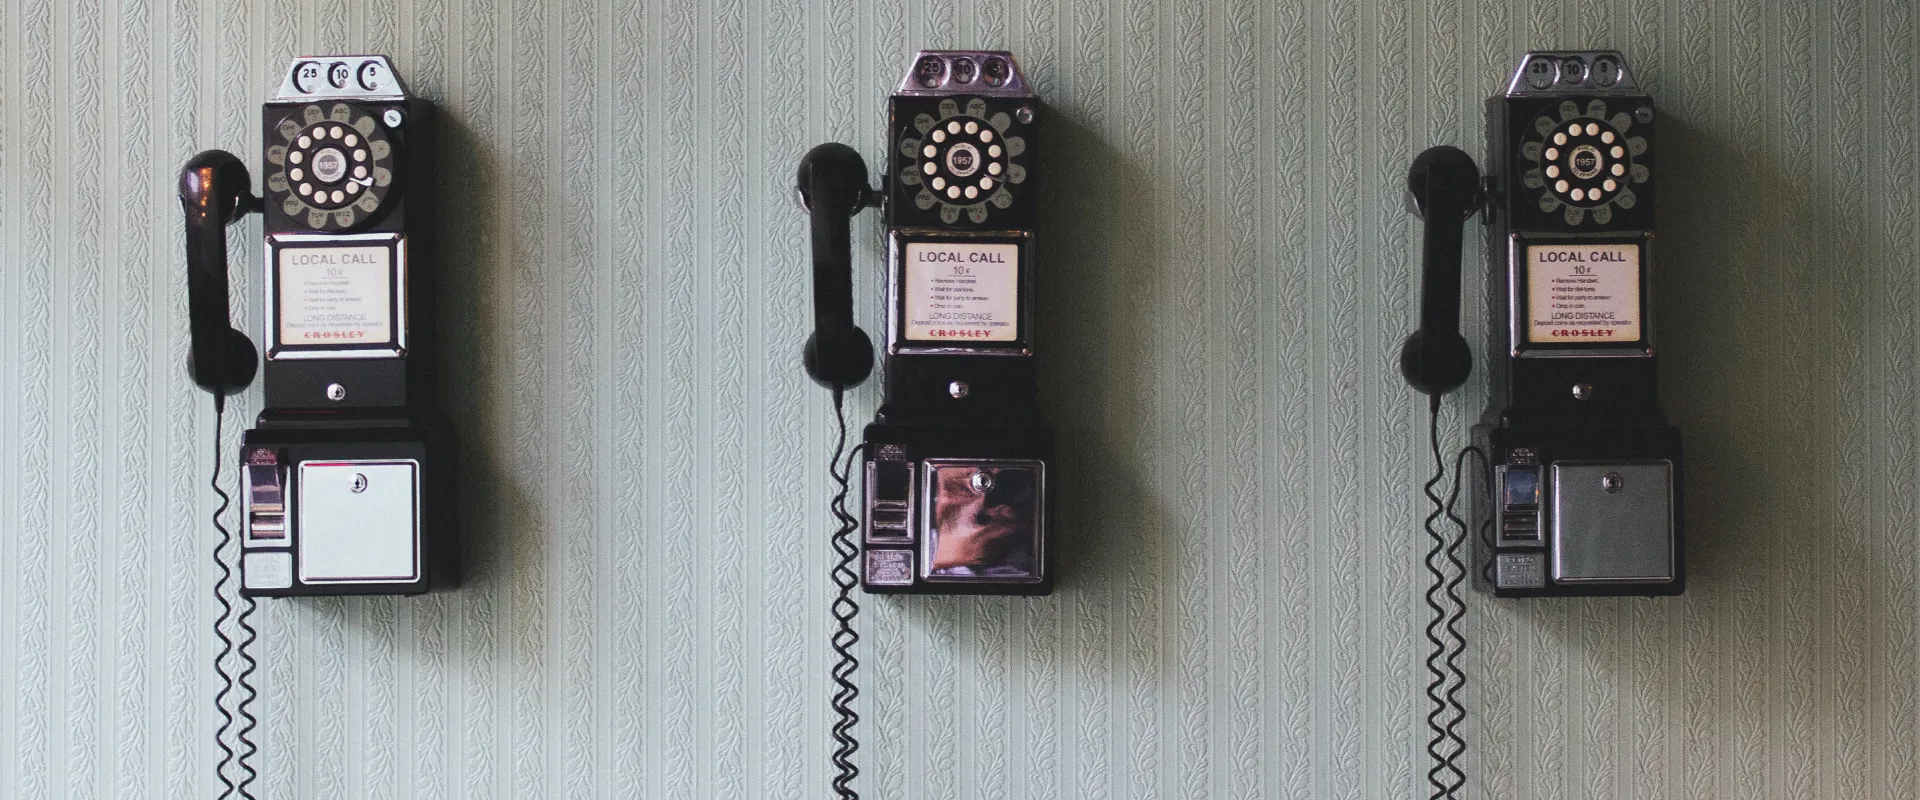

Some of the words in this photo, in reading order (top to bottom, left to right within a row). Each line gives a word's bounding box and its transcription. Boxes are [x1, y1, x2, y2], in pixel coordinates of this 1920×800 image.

[369, 67, 376, 77] 5
[1533, 62, 1548, 74] 25
[1567, 64, 1580, 75] 10
[1600, 62, 1608, 73] 5
[303, 68, 317, 78] 25
[336, 69, 349, 79] 10
[952, 156, 973, 165] 1957
[1576, 158, 1596, 166] 1957
[318, 161, 338, 170] 1957
[292, 254, 337, 265] LOCAL
[341, 254, 377, 265] CALL
[919, 252, 965, 263] LOCAL
[969, 252, 1006, 263] CALL
[1539, 252, 1586, 263] LOCAL
[1590, 251, 1627, 262] CALL
[953, 266, 964, 275] 10
[1574, 265, 1585, 274] 10
[303, 314, 325, 322] LONG
[929, 312, 951, 320] LONG
[953, 312, 993, 321] DISTANCE
[1551, 312, 1574, 320] LONG
[304, 331, 366, 339] CROSLEY
[929, 329, 991, 337] CROSLEY
[1551, 329, 1614, 337] CROSLEY
